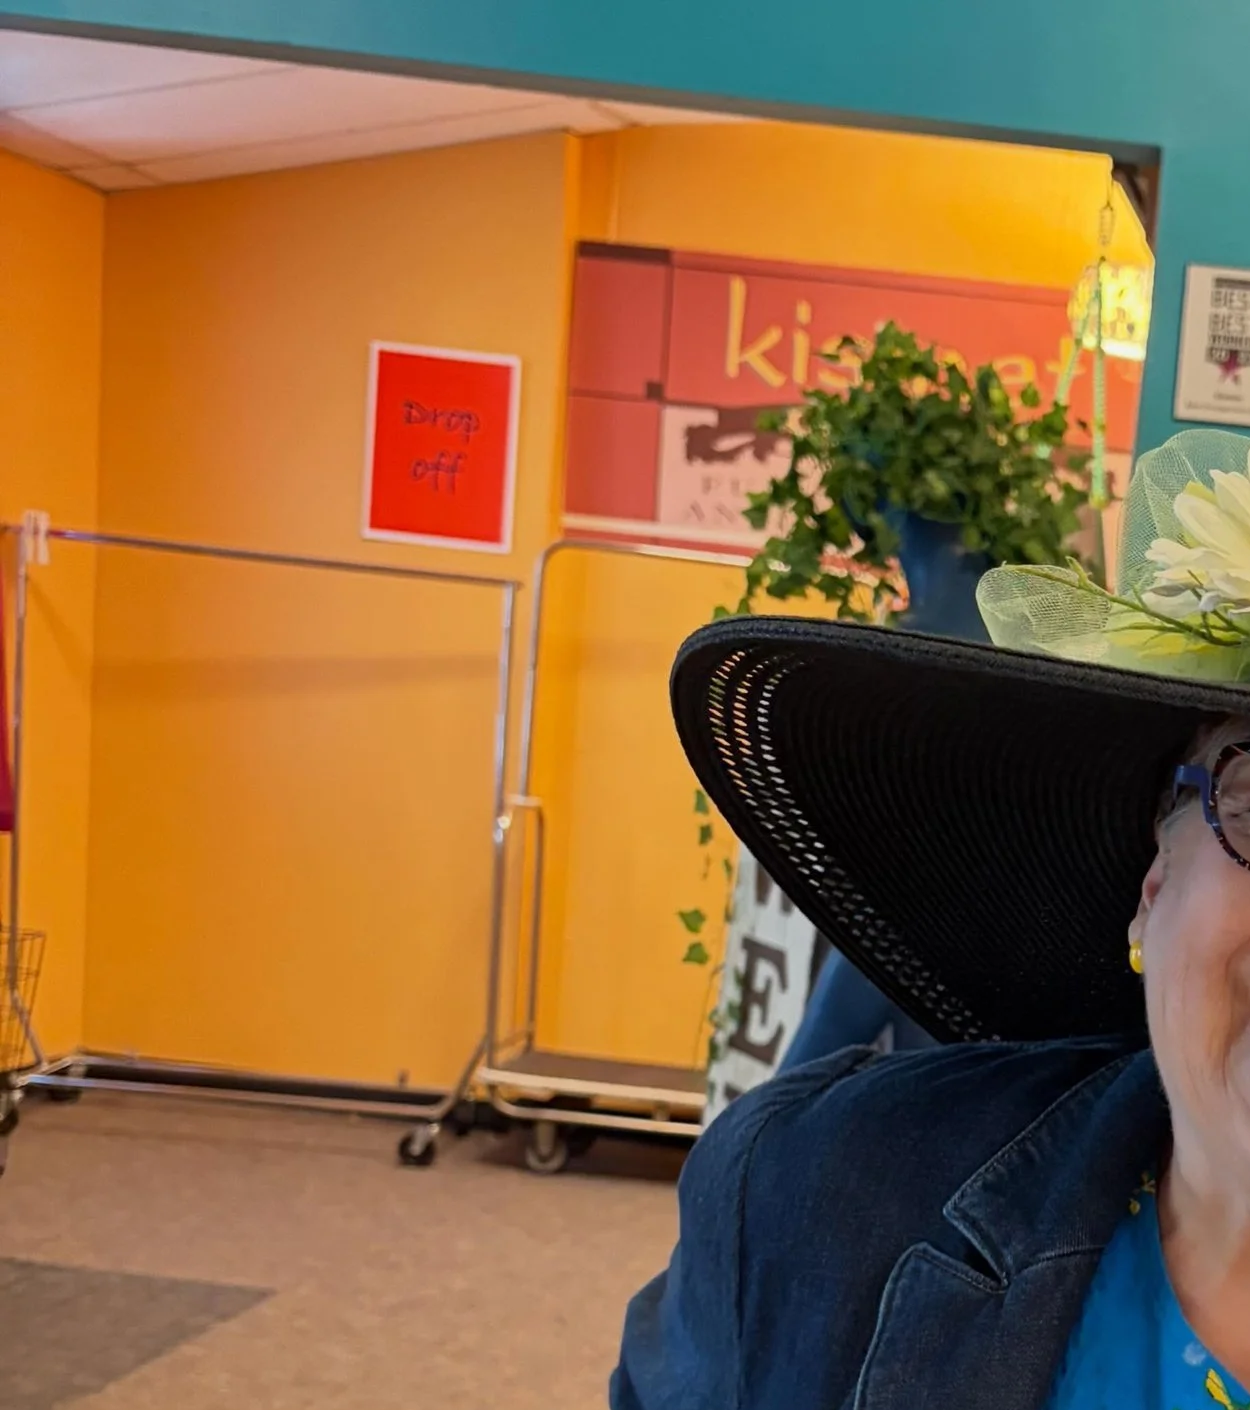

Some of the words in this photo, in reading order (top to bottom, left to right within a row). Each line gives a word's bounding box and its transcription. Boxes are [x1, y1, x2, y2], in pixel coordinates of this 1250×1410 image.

[725, 274, 1087, 412] kiset
[403, 399, 480, 445] Drop
[409, 450, 468, 496] off
